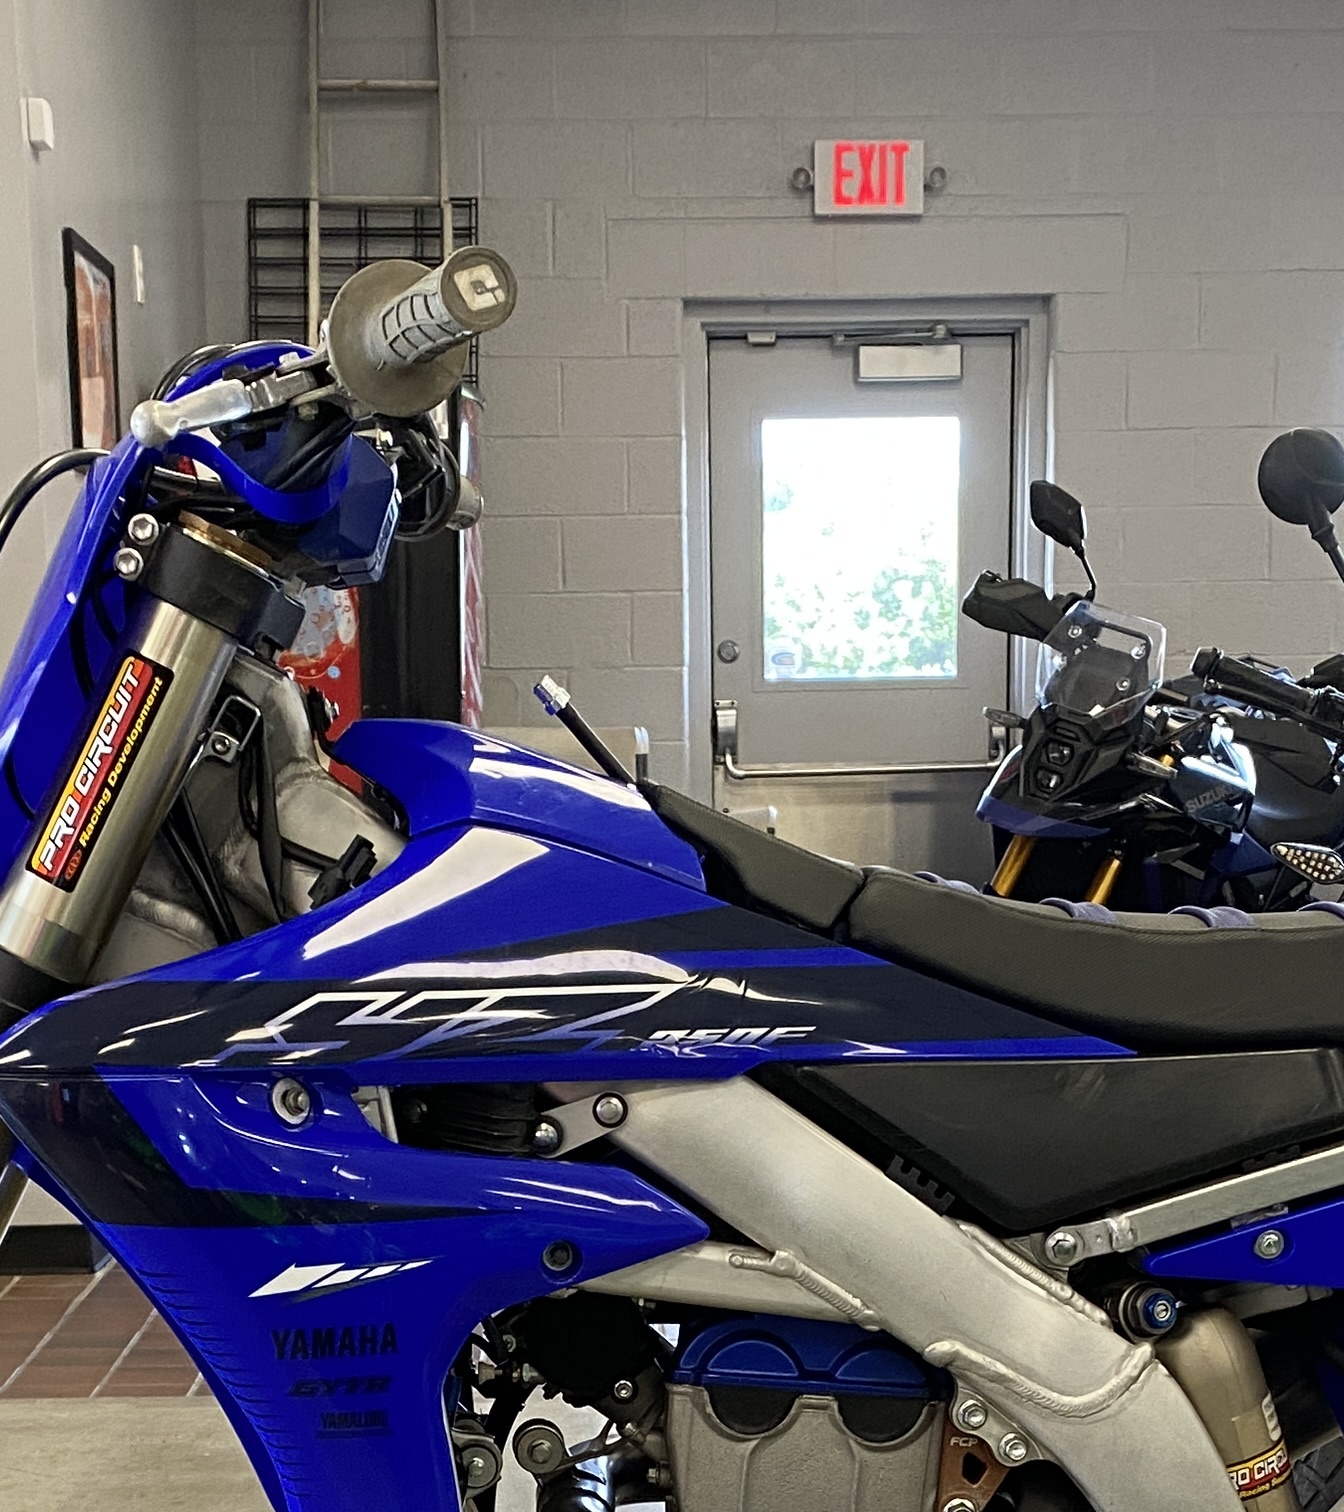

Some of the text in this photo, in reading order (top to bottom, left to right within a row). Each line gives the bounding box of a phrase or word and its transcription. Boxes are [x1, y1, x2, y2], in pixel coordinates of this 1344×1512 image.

[832, 141, 911, 207] EXIT
[39, 662, 140, 871] PRO CIRCUIT
[78, 786, 112, 849] Racing
[270, 1321, 398, 1361] YAMAHA
